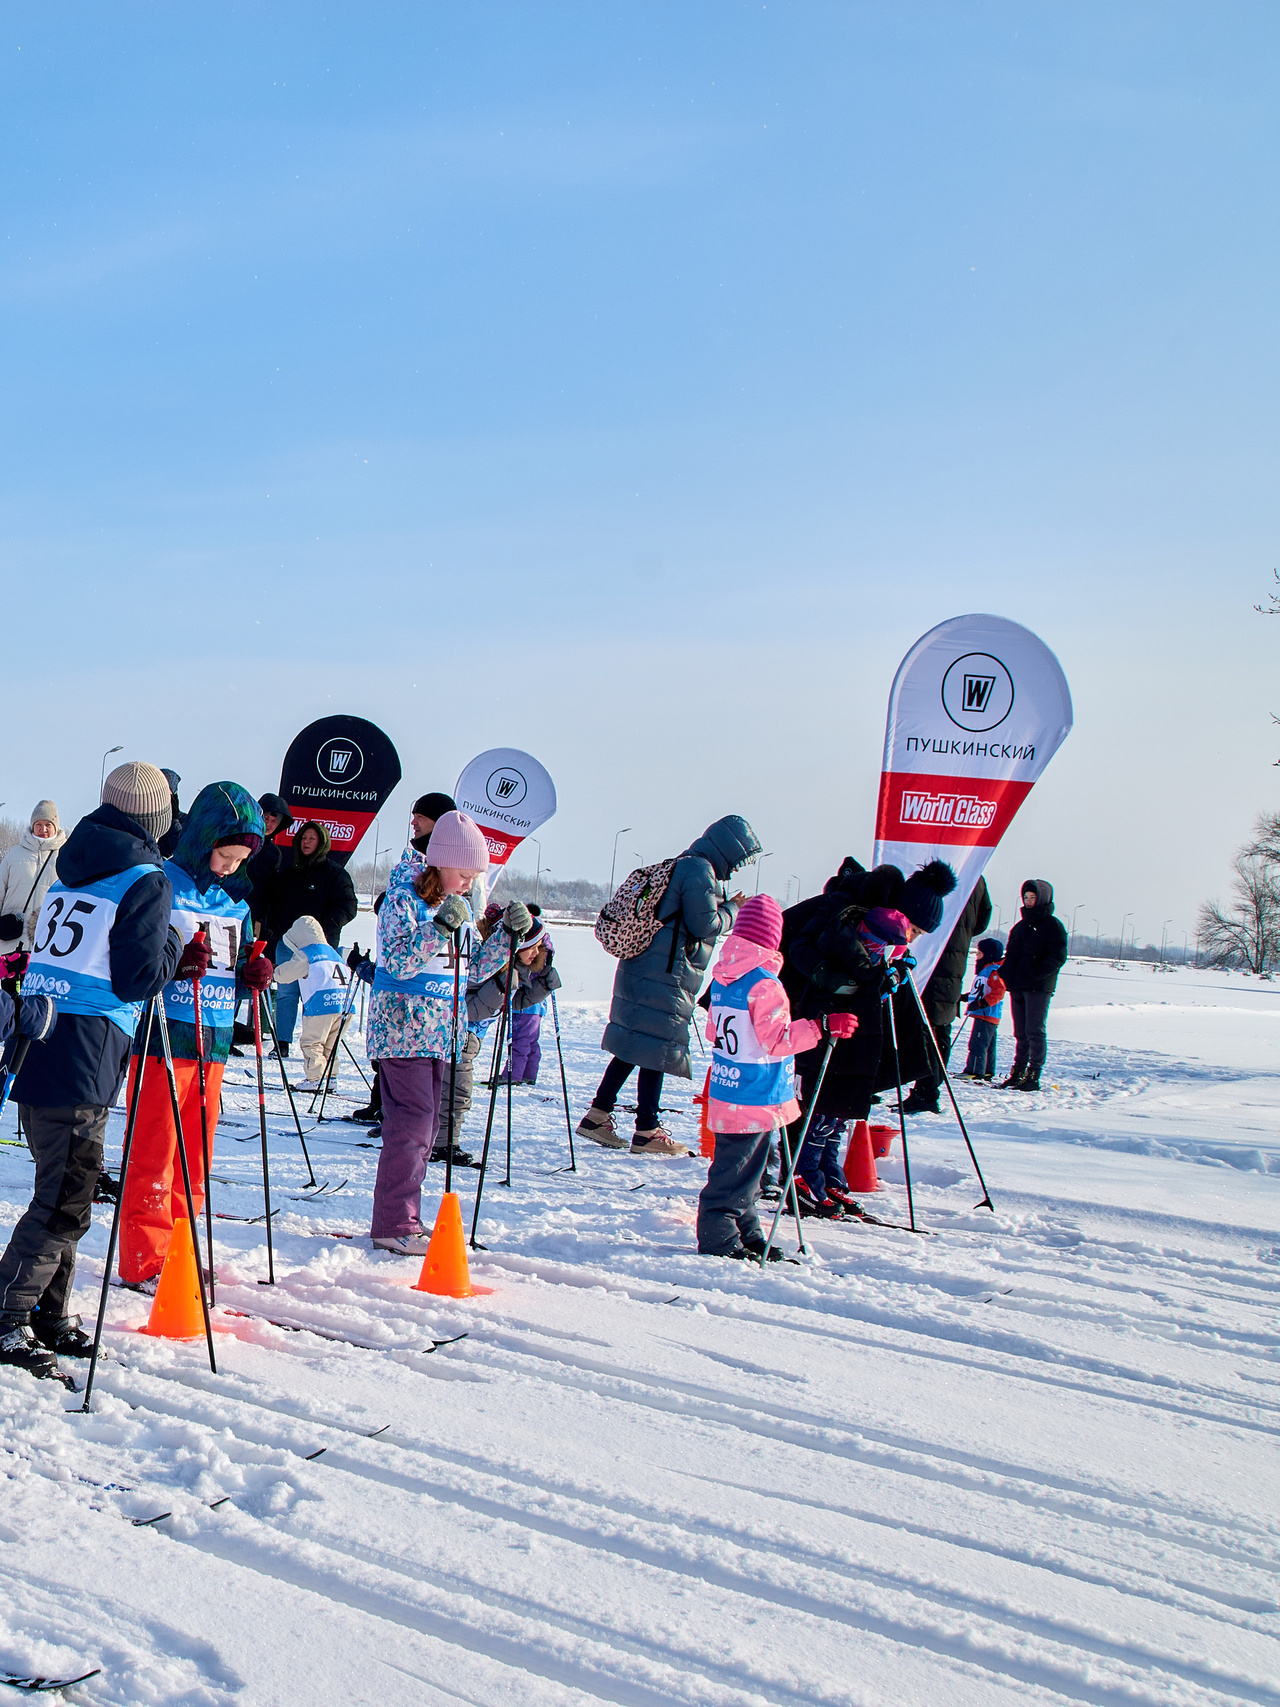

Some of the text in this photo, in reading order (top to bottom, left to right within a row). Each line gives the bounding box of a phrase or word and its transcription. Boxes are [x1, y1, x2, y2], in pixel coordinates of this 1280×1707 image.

[966, 679, 990, 707] W
[906, 737, 1036, 760] ПУШКИНСКИЙ
[292, 785, 377, 801] ПУШКИНСКИЙ
[463, 800, 531, 828] ПУШКИНСКИЙ
[904, 795, 995, 824] World Class
[34, 896, 97, 957] 35
[170, 993, 222, 1009] OUTOOR
[718, 1077, 740, 1088] TEAM
